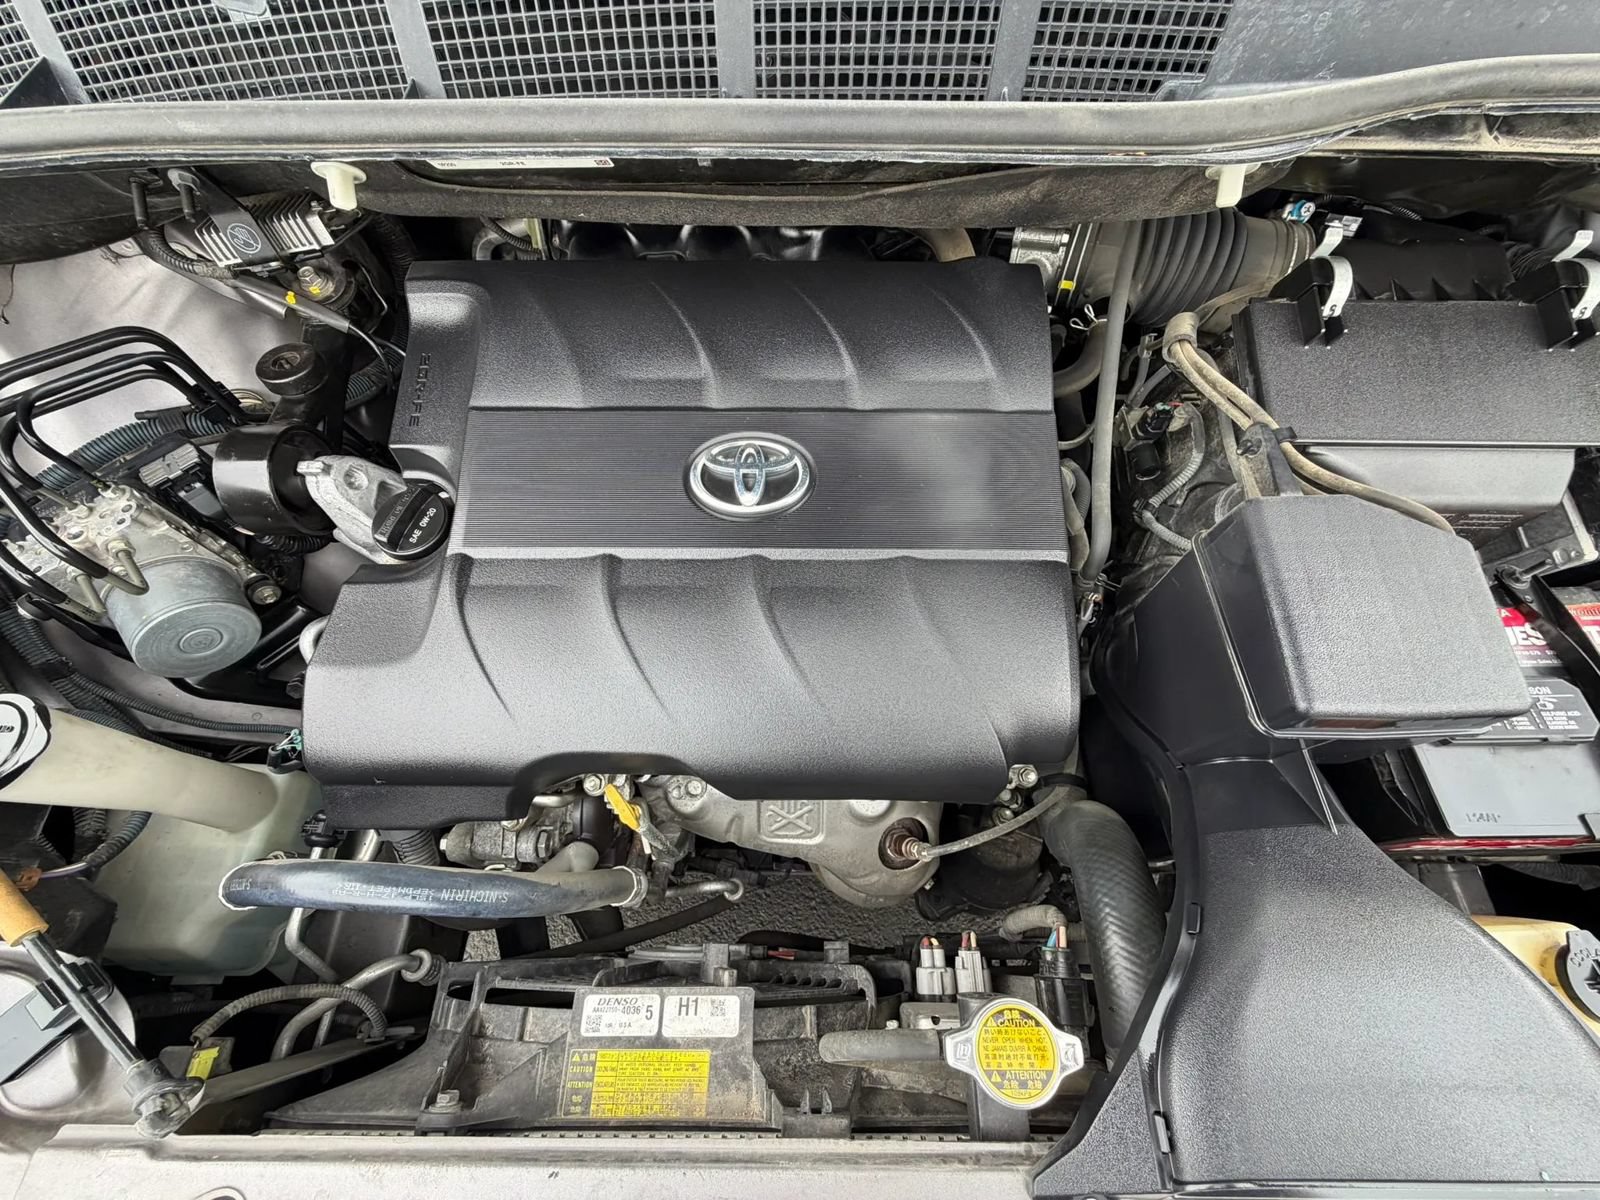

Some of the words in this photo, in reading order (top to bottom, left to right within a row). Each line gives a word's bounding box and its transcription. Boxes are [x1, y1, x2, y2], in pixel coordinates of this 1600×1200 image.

[408, 351, 432, 428] 2GR-FE
[408, 528, 423, 544] SAE
[419, 507, 437, 528] 0W-20
[597, 997, 638, 1006] DENSO
[677, 996, 699, 1017] H1
[645, 1004, 654, 1021] 5
[997, 1019, 1036, 1028] CAUTION
[982, 1036, 999, 1044] NEVER
[1001, 1036, 1016, 1044] OPEN
[569, 1065, 593, 1073] CAUTION
[1005, 1070, 1047, 1080] ATTENTION
[567, 1081, 593, 1089] ATTENTION
